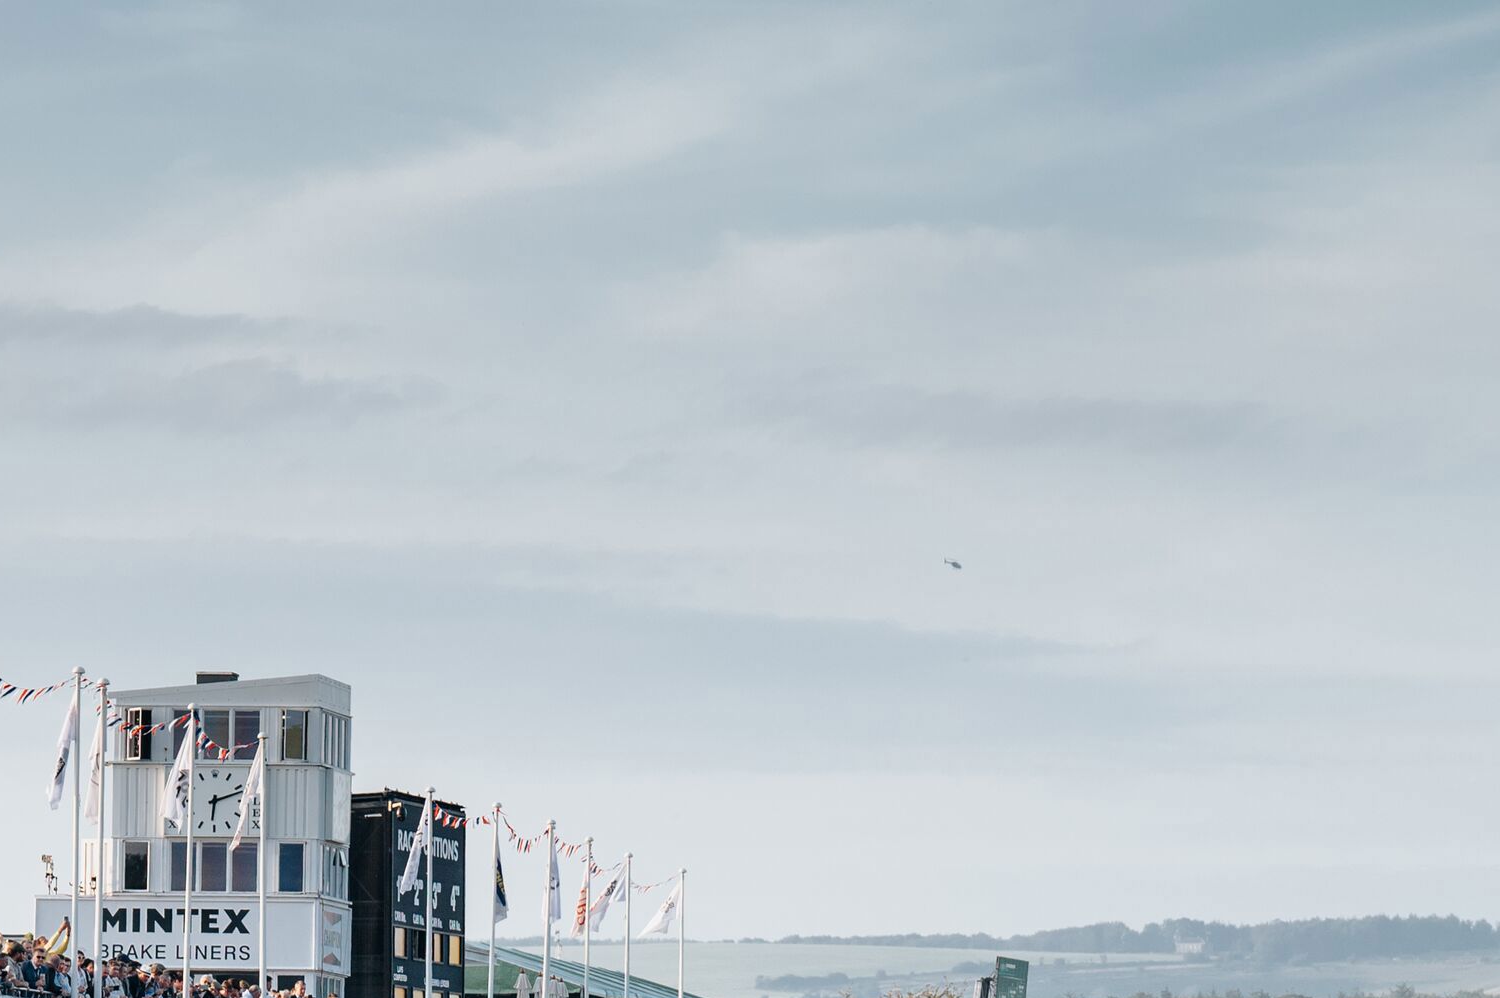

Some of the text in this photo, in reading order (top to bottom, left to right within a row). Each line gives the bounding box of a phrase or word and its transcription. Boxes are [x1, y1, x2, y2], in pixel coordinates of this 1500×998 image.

[397, 829, 417, 851] RAC
[102, 907, 251, 934] MINTEX
[101, 944, 167, 960] BRAKE
